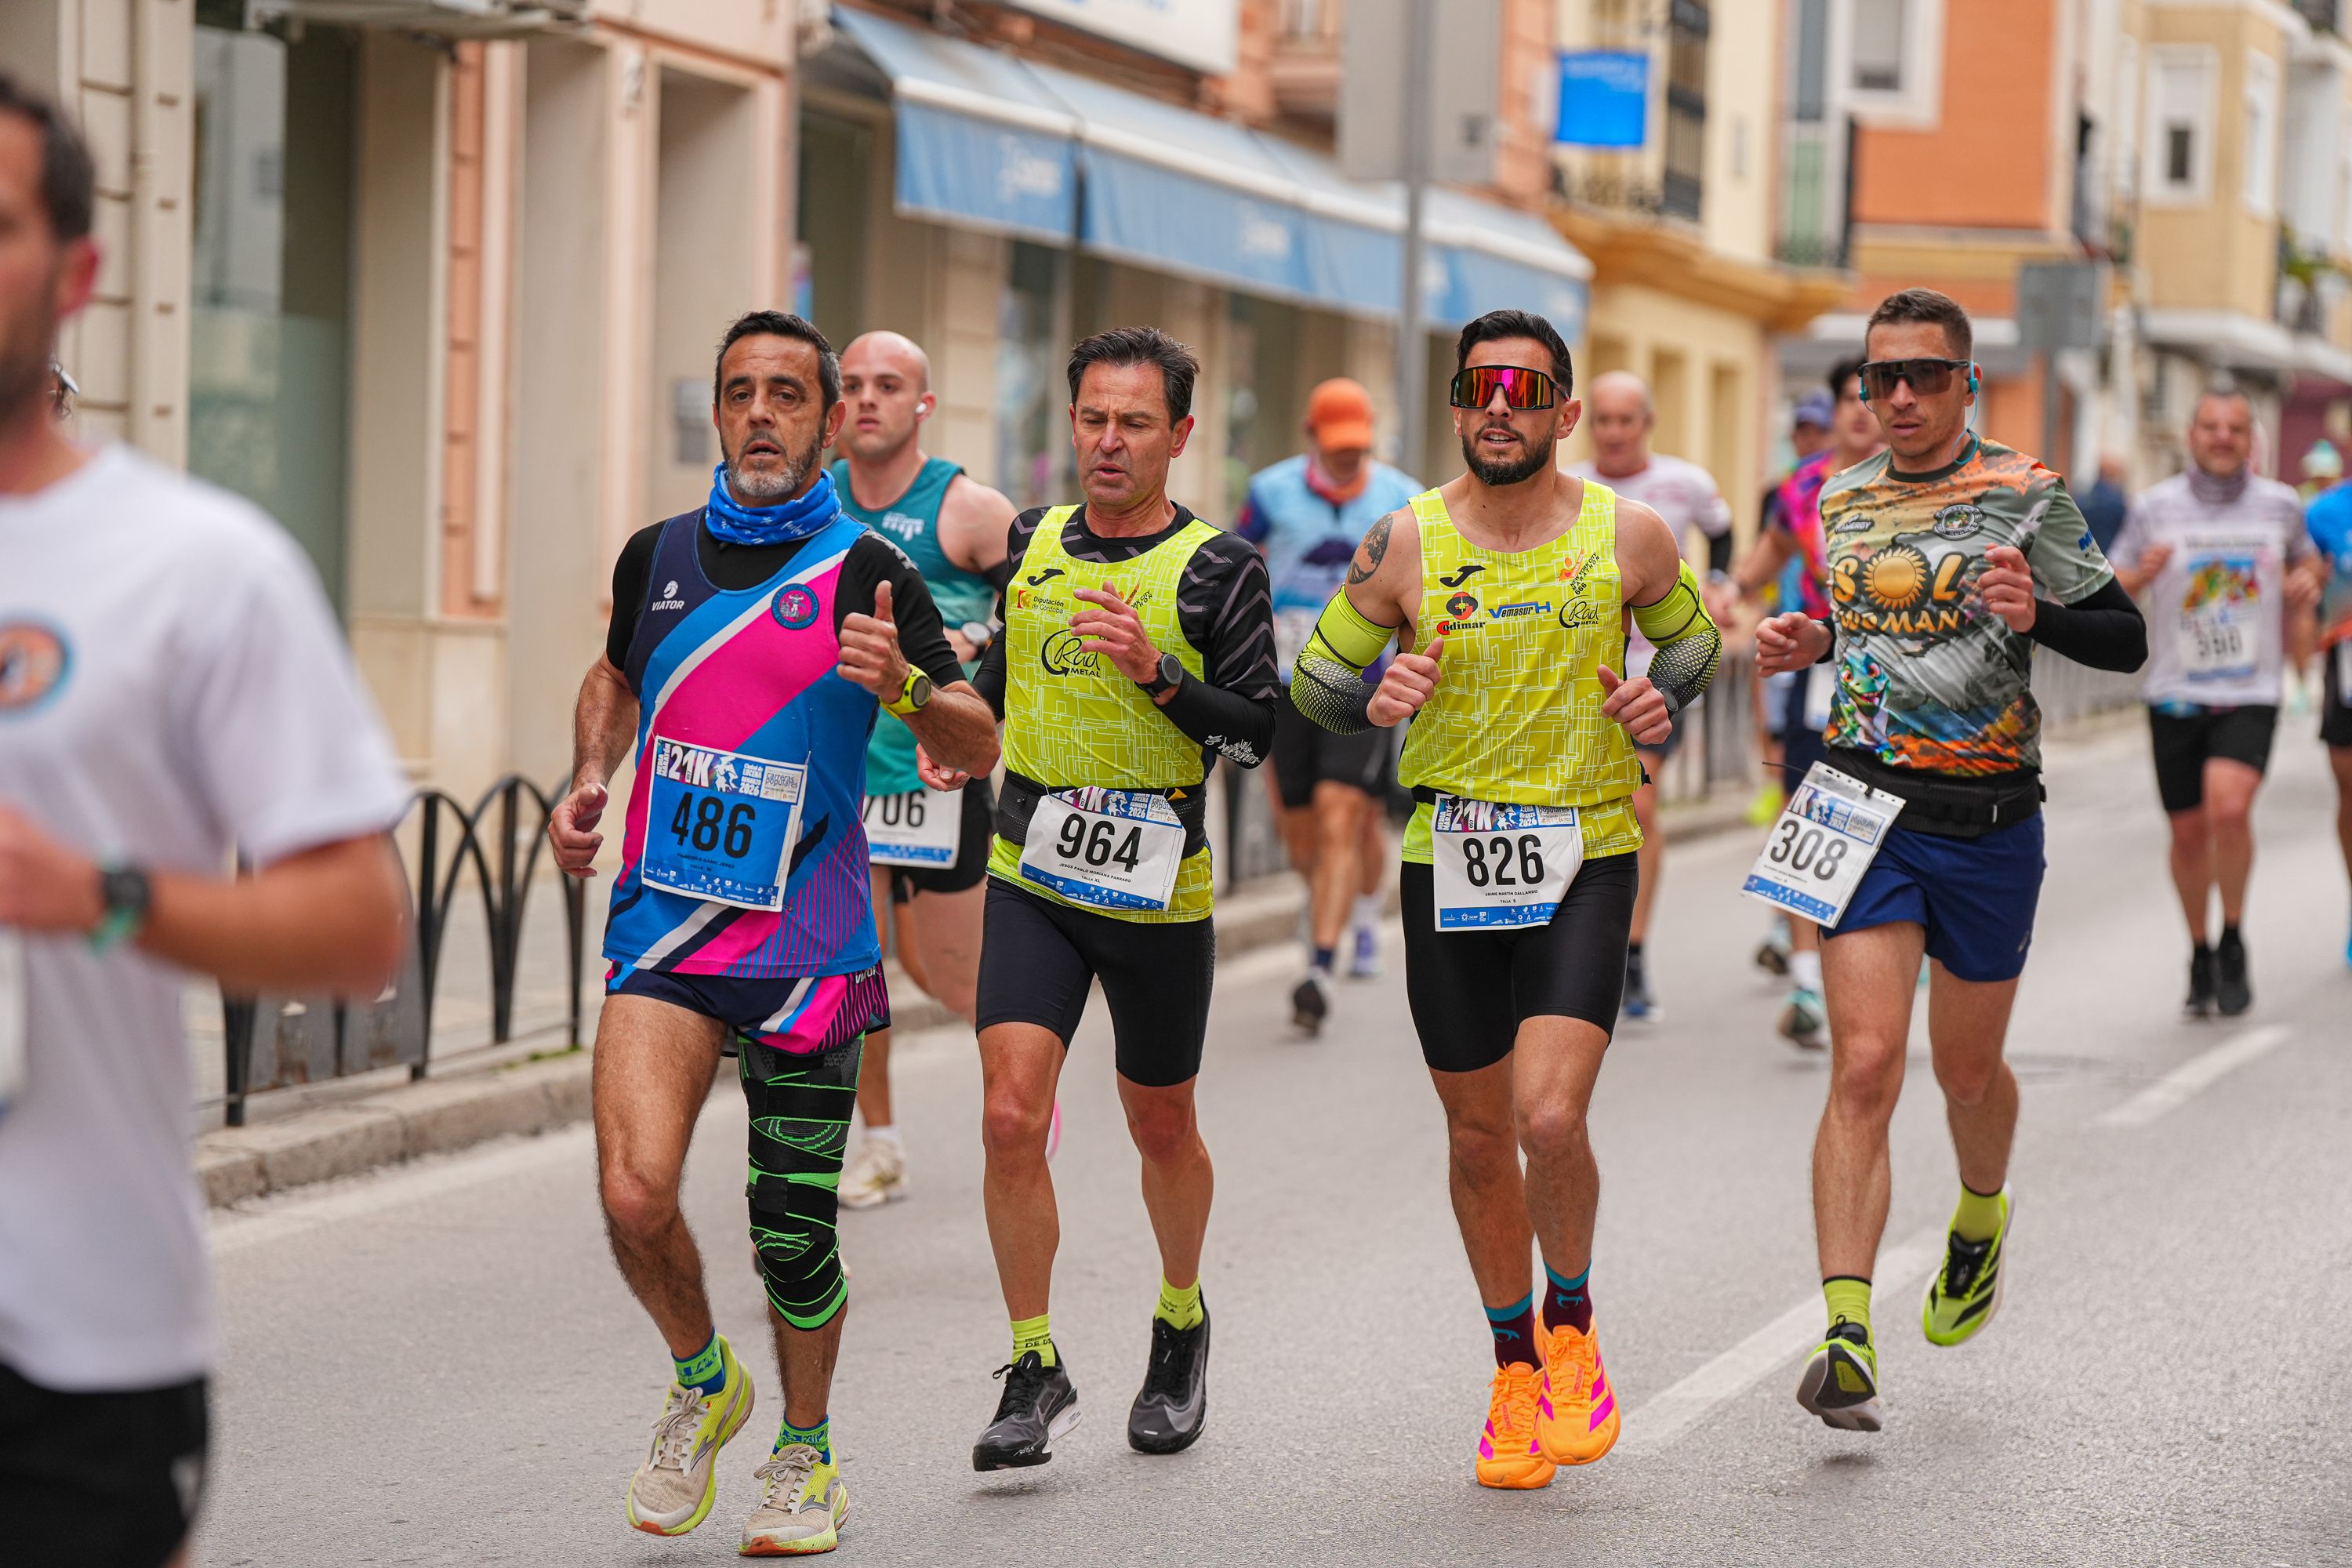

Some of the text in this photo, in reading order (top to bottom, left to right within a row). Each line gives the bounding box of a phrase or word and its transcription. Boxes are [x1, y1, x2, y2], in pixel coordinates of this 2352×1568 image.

[1575, 583, 1587, 595] 666
[652, 600, 684, 612] VIATOR
[1033, 596, 1064, 608] Diputación
[1040, 604, 1063, 614] Córdoba
[1436, 621, 1485, 635] Codimar
[1071, 667, 1100, 677] METAL
[668, 745, 714, 787] 21K
[767, 772, 795, 782] carreras
[739, 782, 760, 797] 2026
[765, 778, 798, 789] populares
[1128, 807, 1145, 818] 2026
[1450, 800, 1494, 831] 21K
[670, 792, 756, 858] 486
[1519, 817, 1537, 827] 2026
[1056, 813, 1142, 873] 964
[1770, 819, 1849, 880] 308
[1463, 834, 1544, 887] 826
